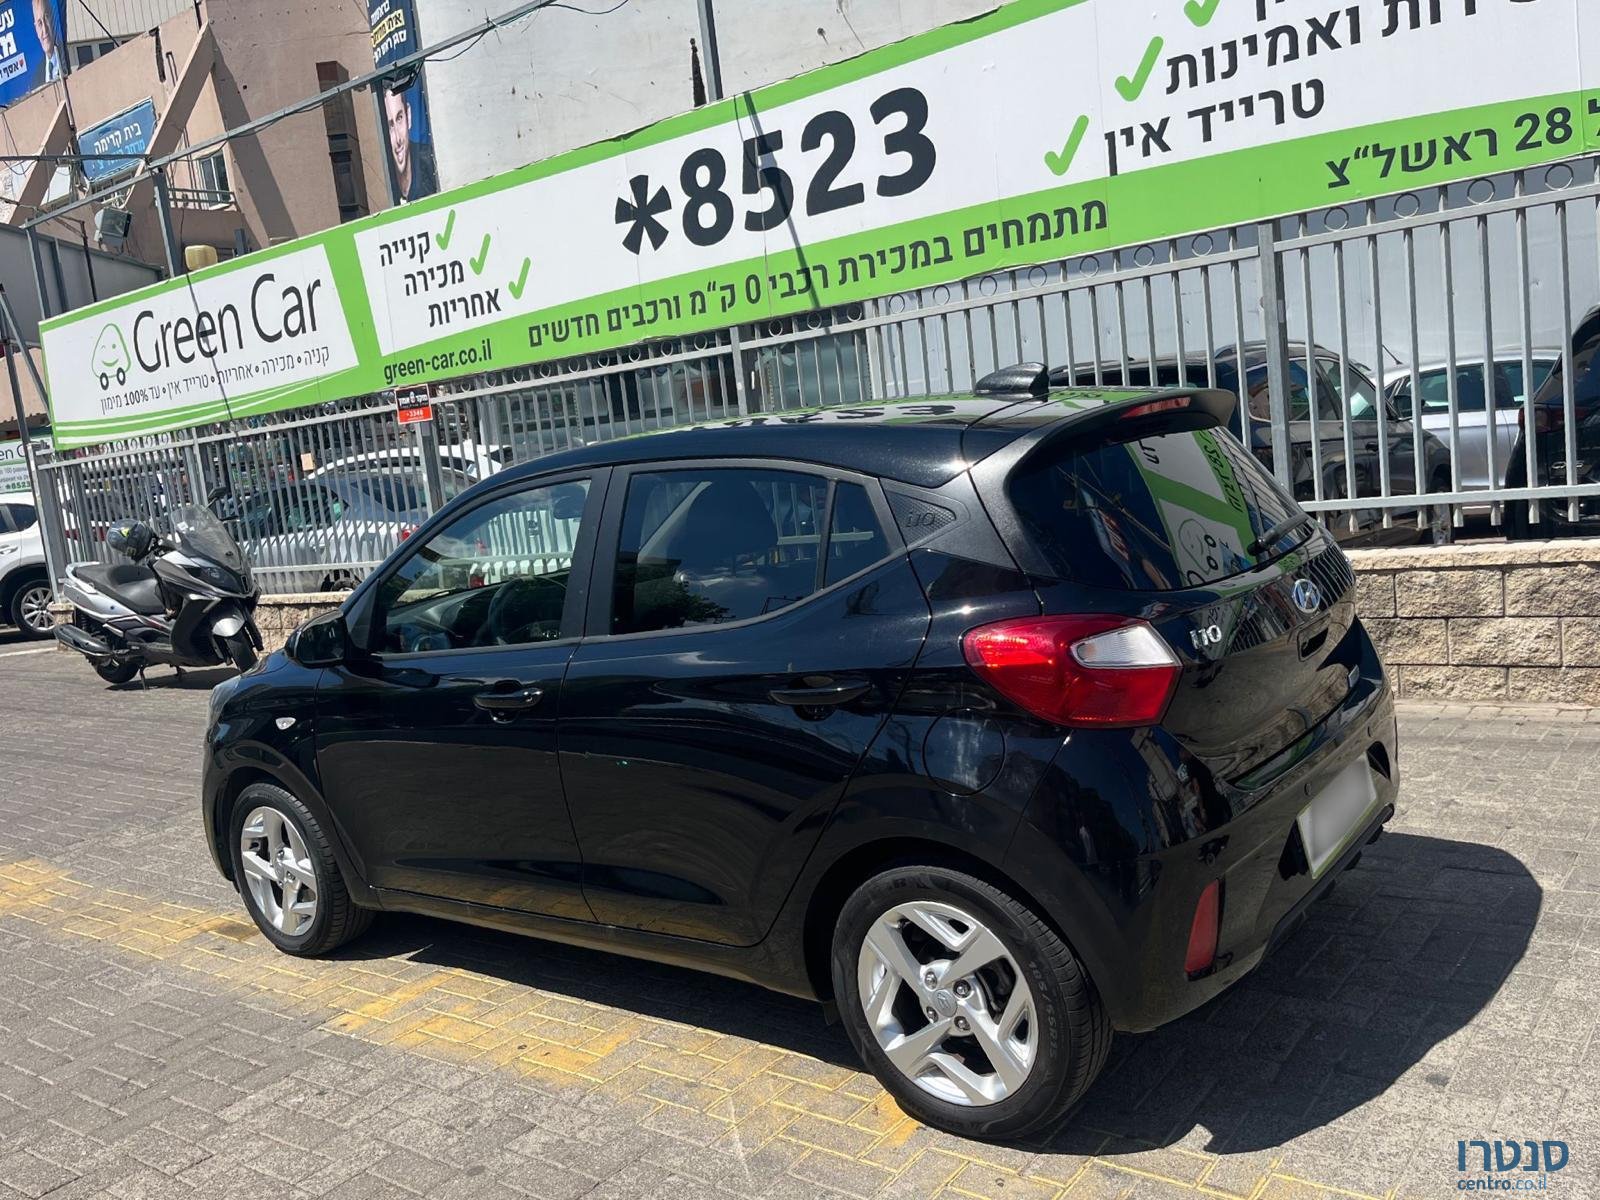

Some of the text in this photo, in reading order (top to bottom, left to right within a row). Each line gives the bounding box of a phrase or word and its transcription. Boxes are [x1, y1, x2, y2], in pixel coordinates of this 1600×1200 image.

[1166, 6, 1361, 95] ואמינות
[1104, 79, 1324, 176] טרייד אין
[1514, 107, 1573, 151] 28
[379, 231, 430, 267] קנייה
[963, 200, 1107, 257] מתמחים
[404, 260, 464, 296] מכירה
[768, 264, 829, 298] רכבי
[838, 236, 953, 286] במכירת
[428, 288, 501, 327] אחריות
[745, 274, 761, 304] 0
[133, 273, 321, 373] Green Car
[528, 314, 600, 347] חדשים
[607, 295, 681, 332] ורכבים
[100, 346, 330, 415] קניה מכירה אחריות טרייד אין עד 100% מימון
[384, 338, 492, 385] green-car.co.il
